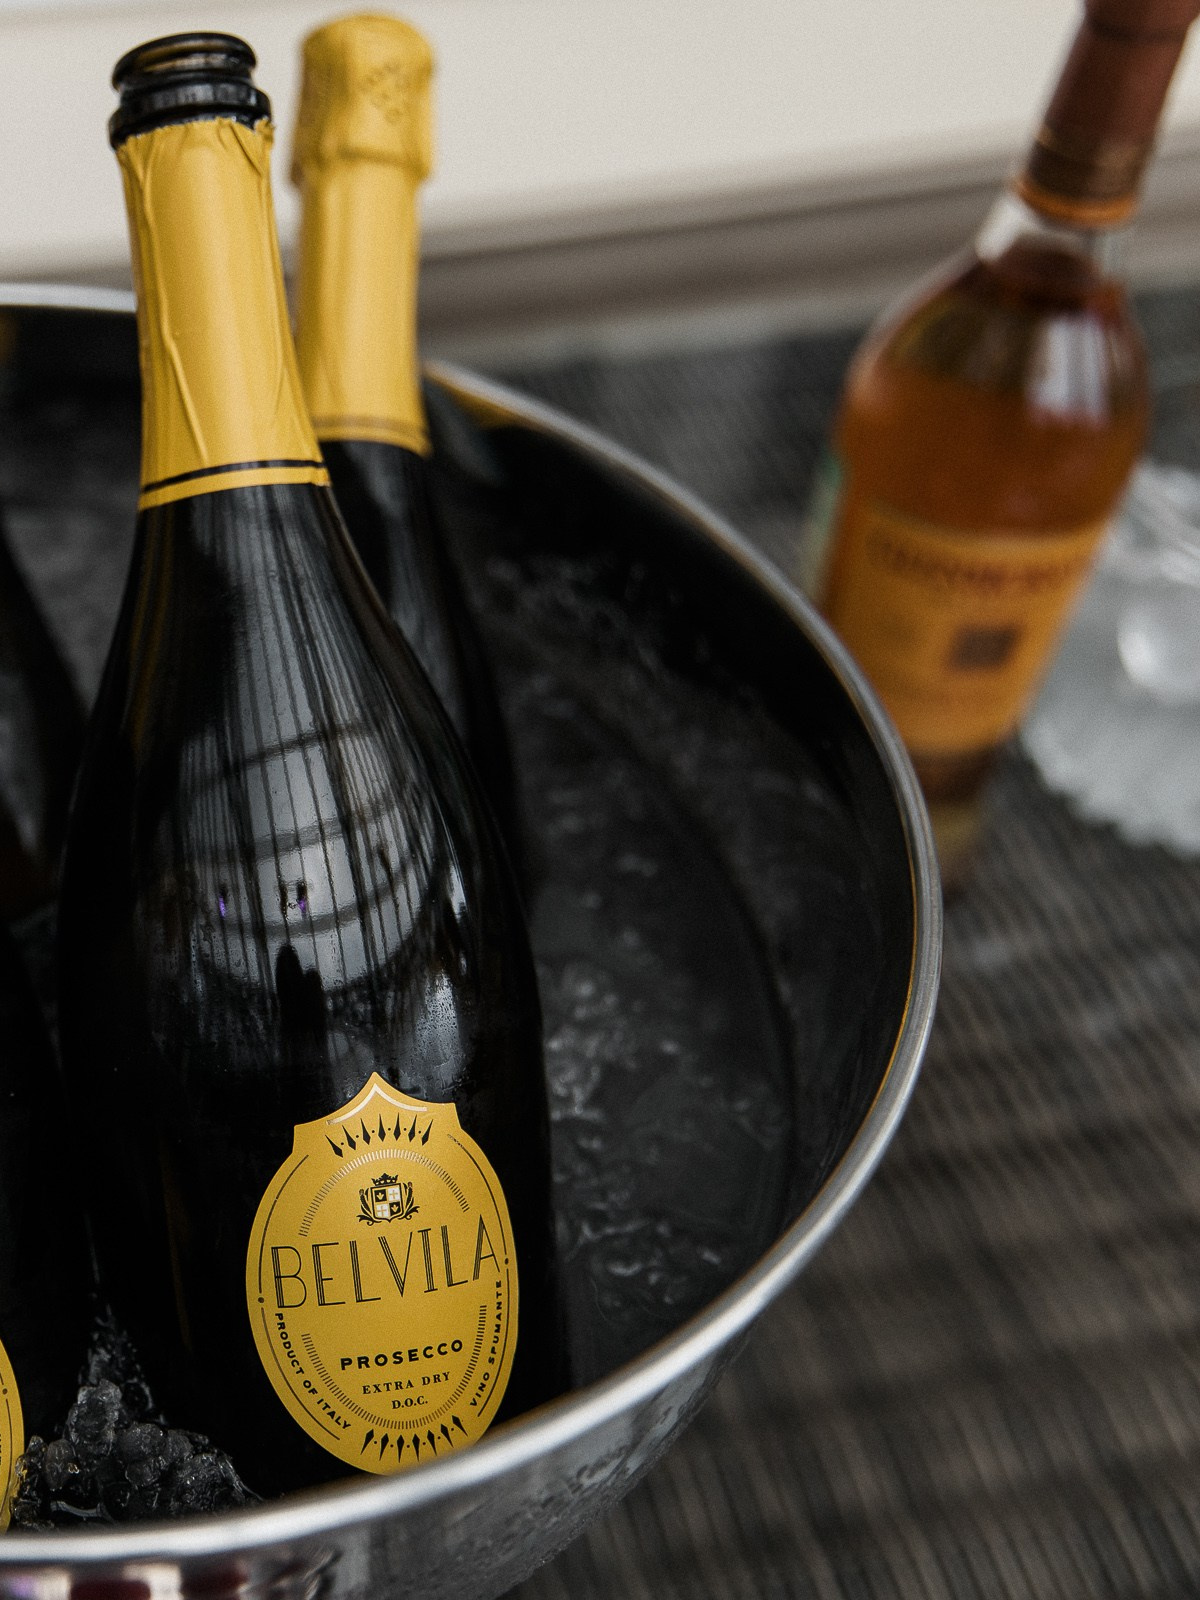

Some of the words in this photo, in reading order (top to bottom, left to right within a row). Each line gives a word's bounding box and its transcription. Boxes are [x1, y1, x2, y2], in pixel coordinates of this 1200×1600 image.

[271, 1214, 500, 1309] BELVILA
[275, 1313, 304, 1375] PRODUCT
[303, 1380, 318, 1395] OF
[317, 1398, 351, 1430] ITALY
[340, 1339, 463, 1371] PROSECCO
[470, 1372, 490, 1406] VINO
[488, 1280, 502, 1365] SPUMANTE
[362, 1379, 414, 1395] EXTRA
[421, 1371, 451, 1386] DRY
[392, 1395, 428, 1410] D.O.C.
